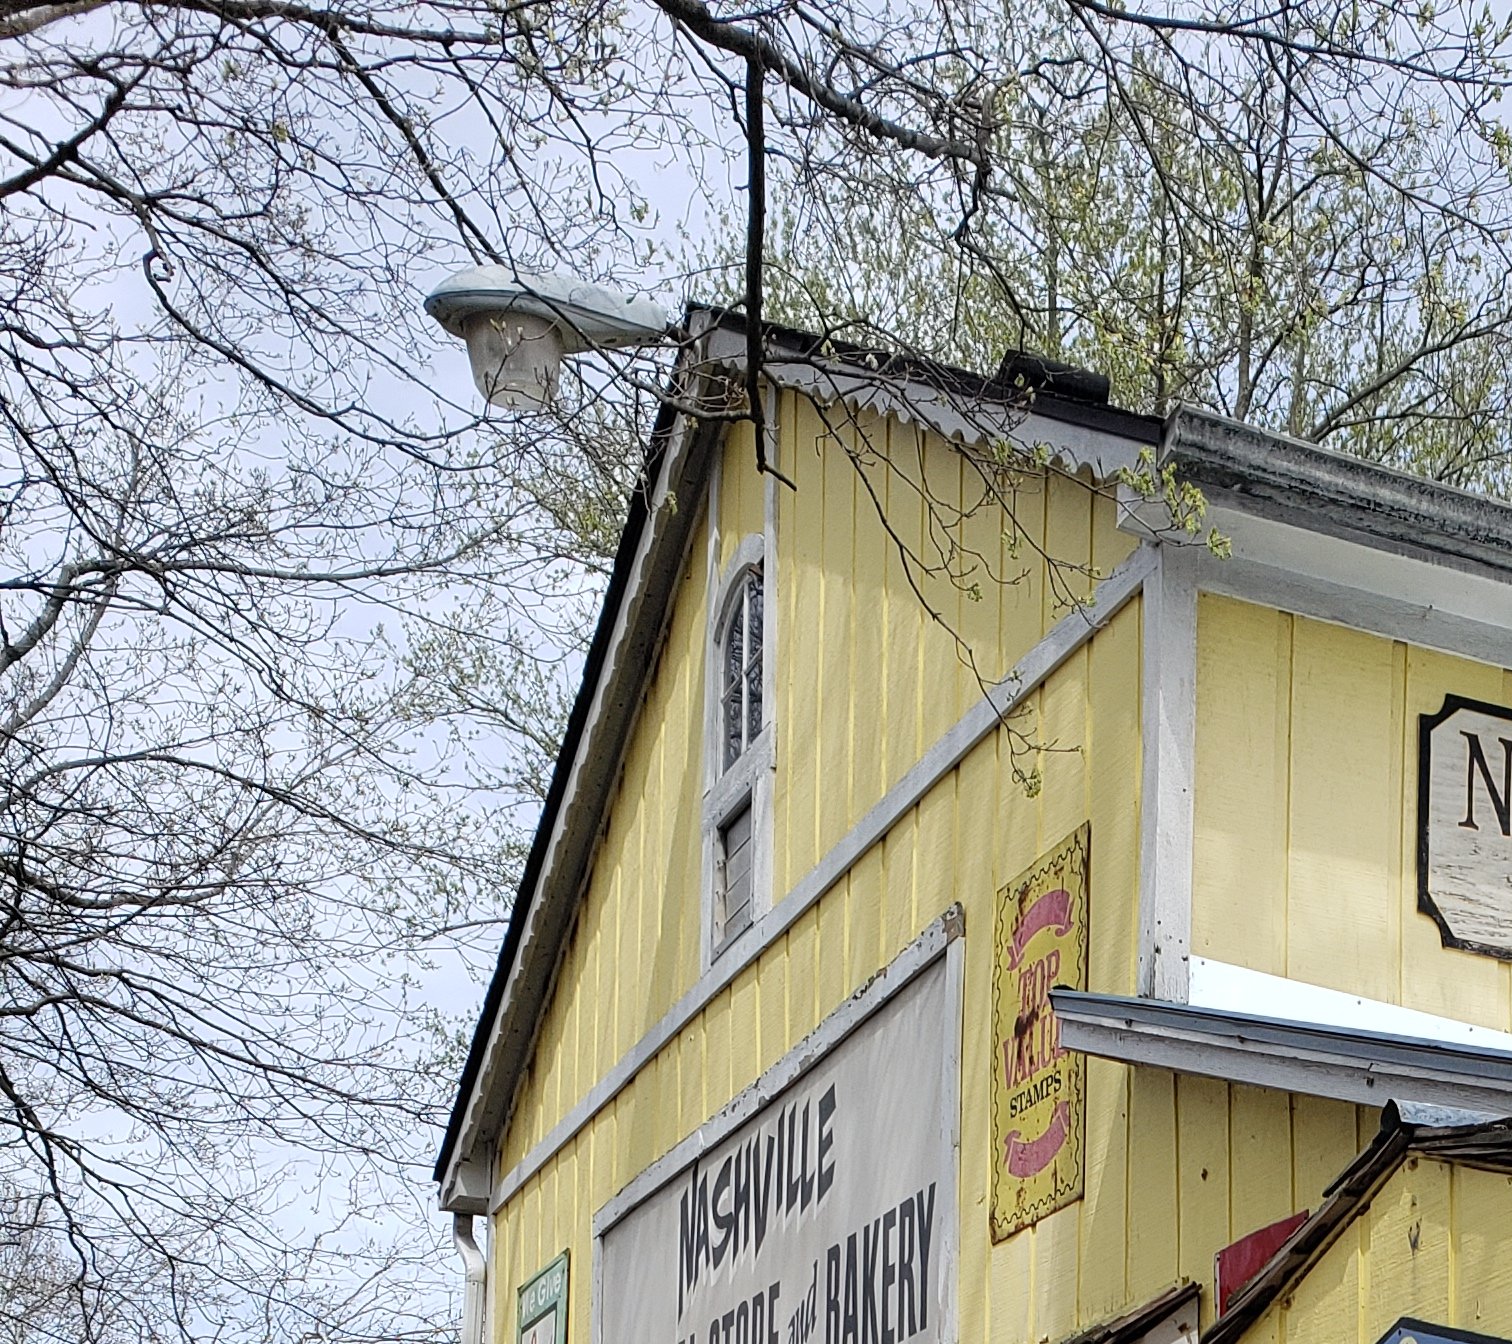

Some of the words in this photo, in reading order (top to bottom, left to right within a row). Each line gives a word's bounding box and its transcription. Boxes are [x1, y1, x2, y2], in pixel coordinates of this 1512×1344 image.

[1019, 949, 1061, 1015] TOP
[1002, 1010, 1066, 1091] VALU
[1009, 1071, 1063, 1119] STAMPS
[677, 1081, 838, 1324] NASHVILLE
